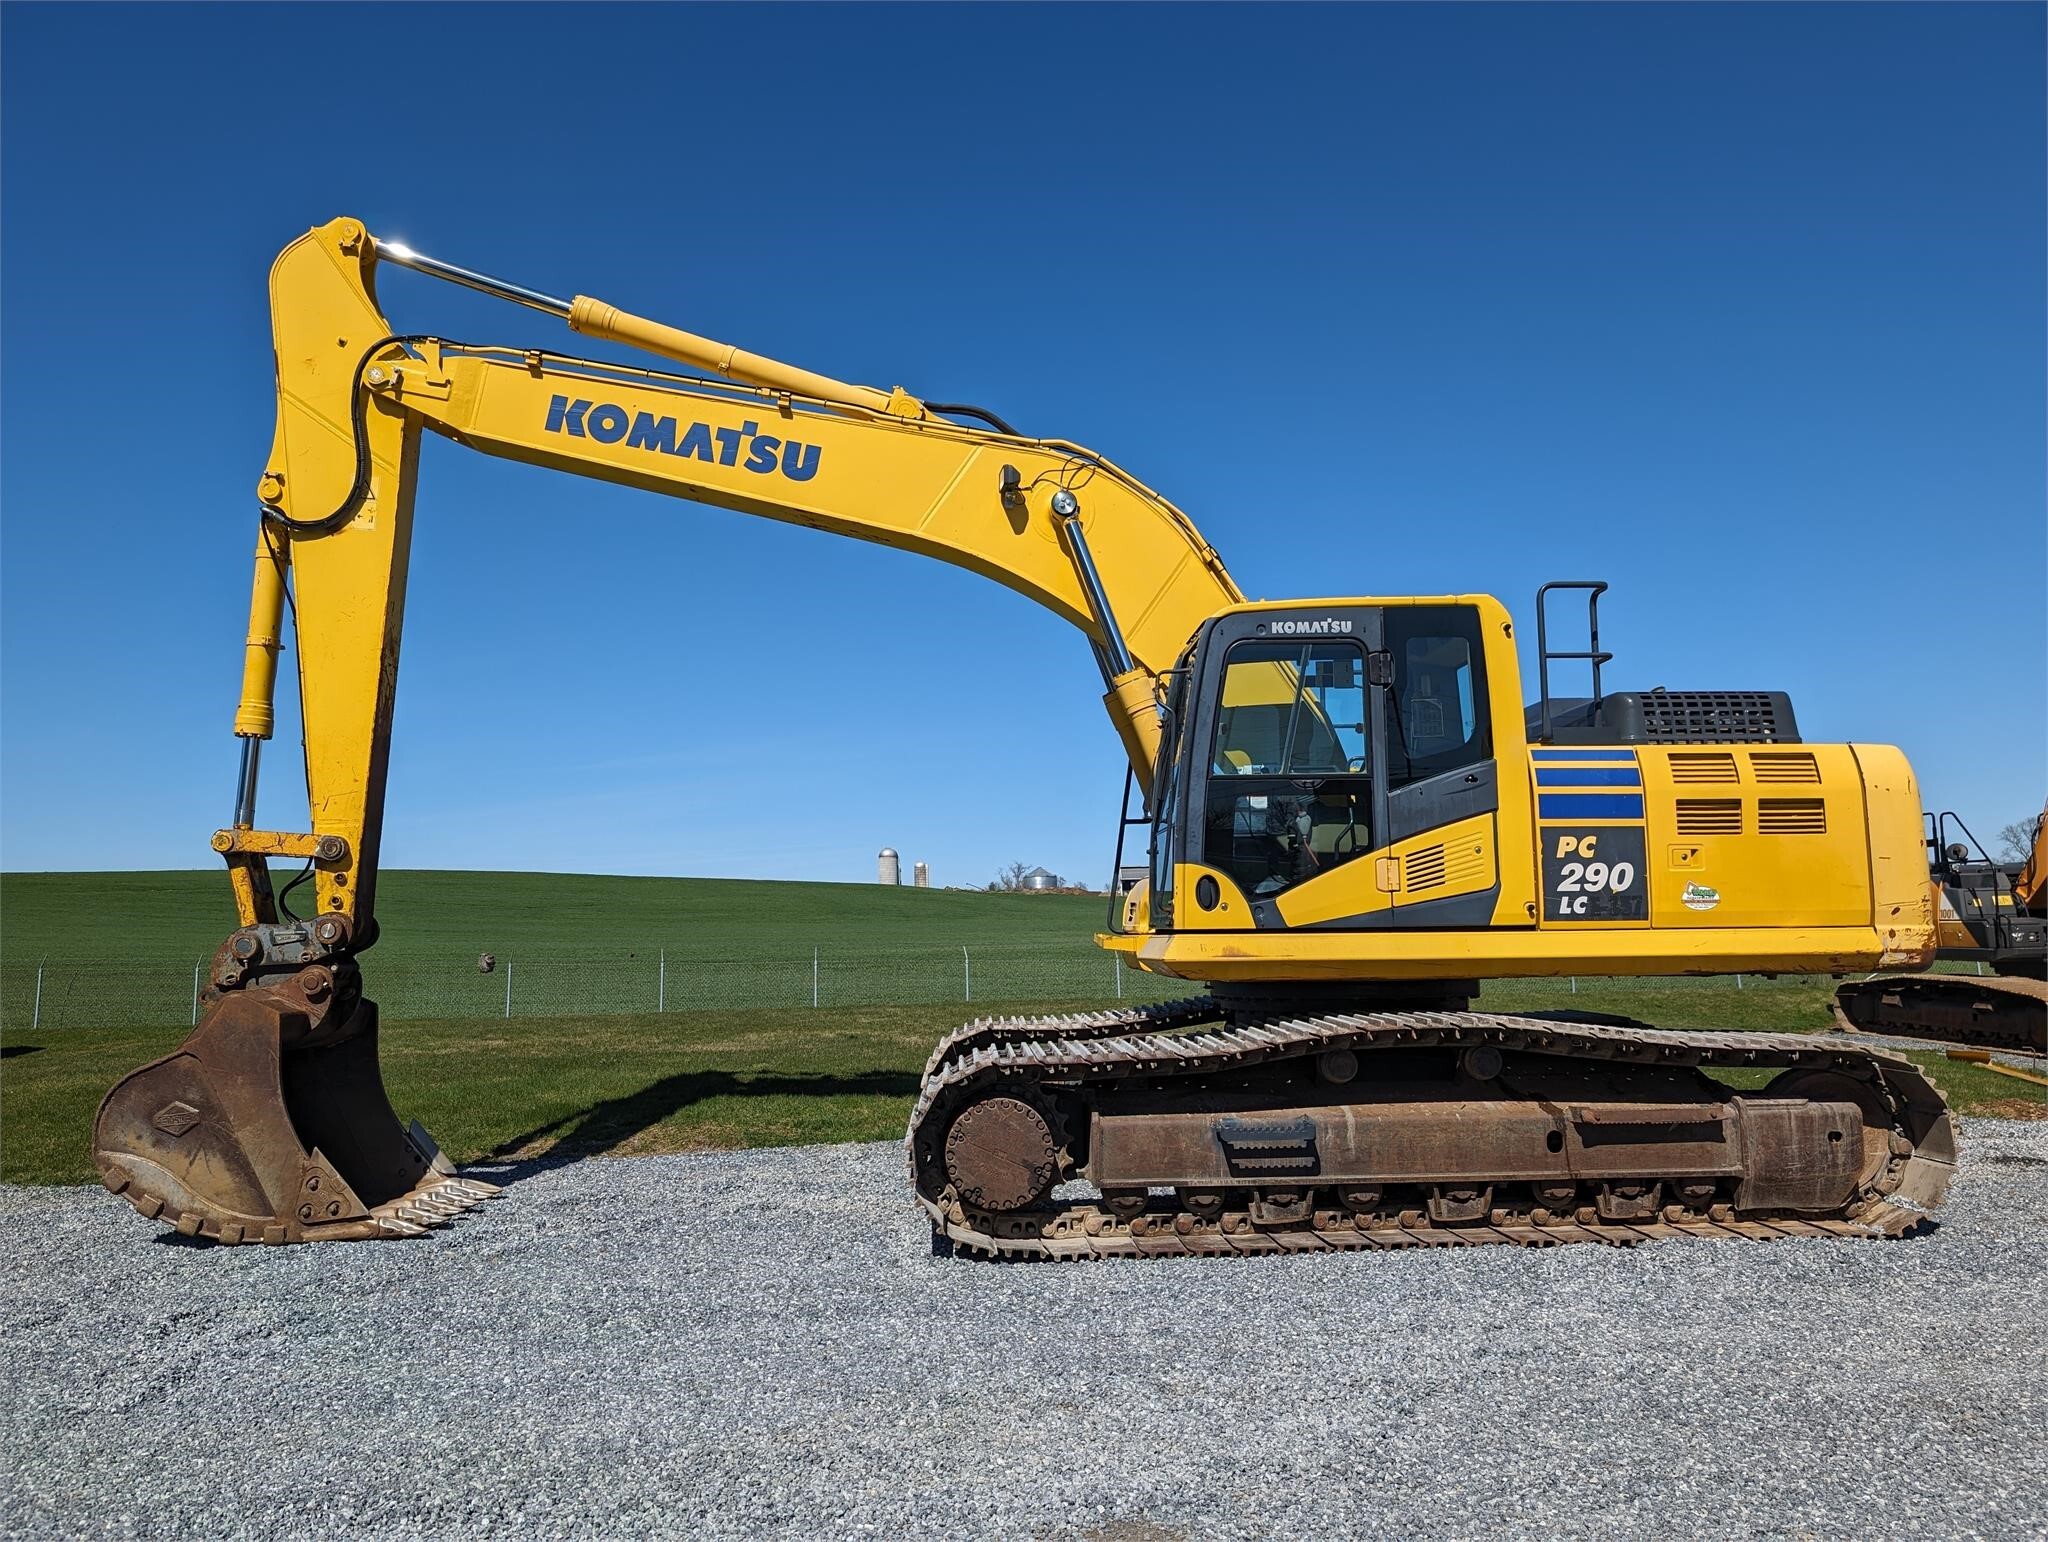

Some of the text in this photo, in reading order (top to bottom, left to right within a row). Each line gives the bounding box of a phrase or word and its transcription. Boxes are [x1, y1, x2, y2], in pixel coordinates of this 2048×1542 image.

[545, 394, 822, 482] KOMATSU
[1271, 617, 1352, 634] KOMATSU
[1556, 835, 1597, 858] PC
[1557, 862, 1634, 893] 290
[1559, 896, 1588, 914] LC
